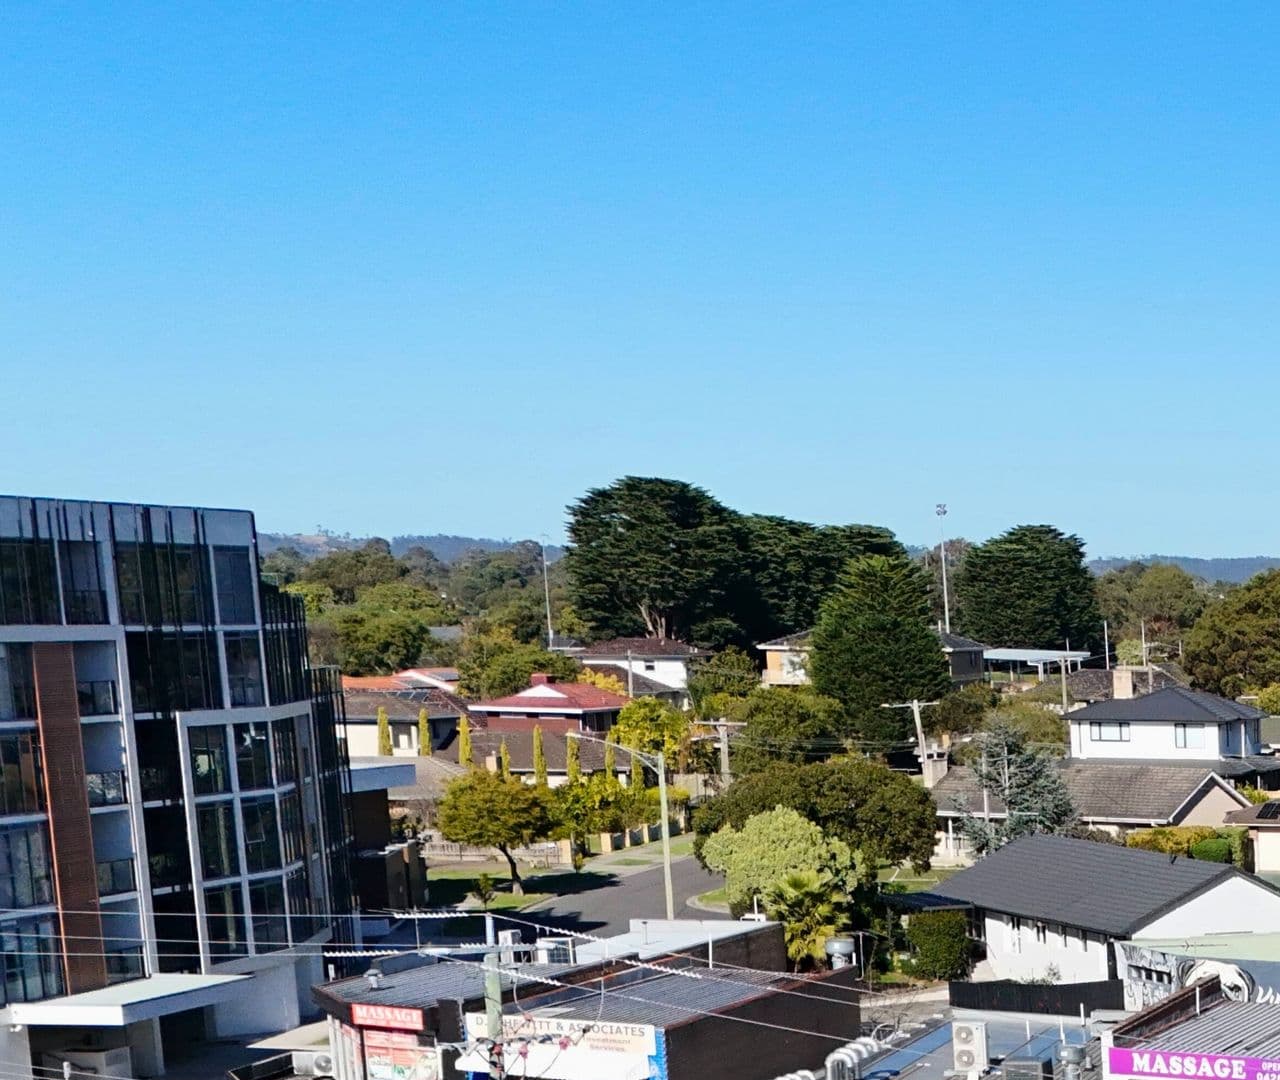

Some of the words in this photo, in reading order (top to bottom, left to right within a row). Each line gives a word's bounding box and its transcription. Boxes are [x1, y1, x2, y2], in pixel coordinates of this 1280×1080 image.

[355, 1004, 419, 1023] MASSAGE
[556, 1022, 564, 1031] &
[1131, 1052, 1247, 1080] MASSAGE
